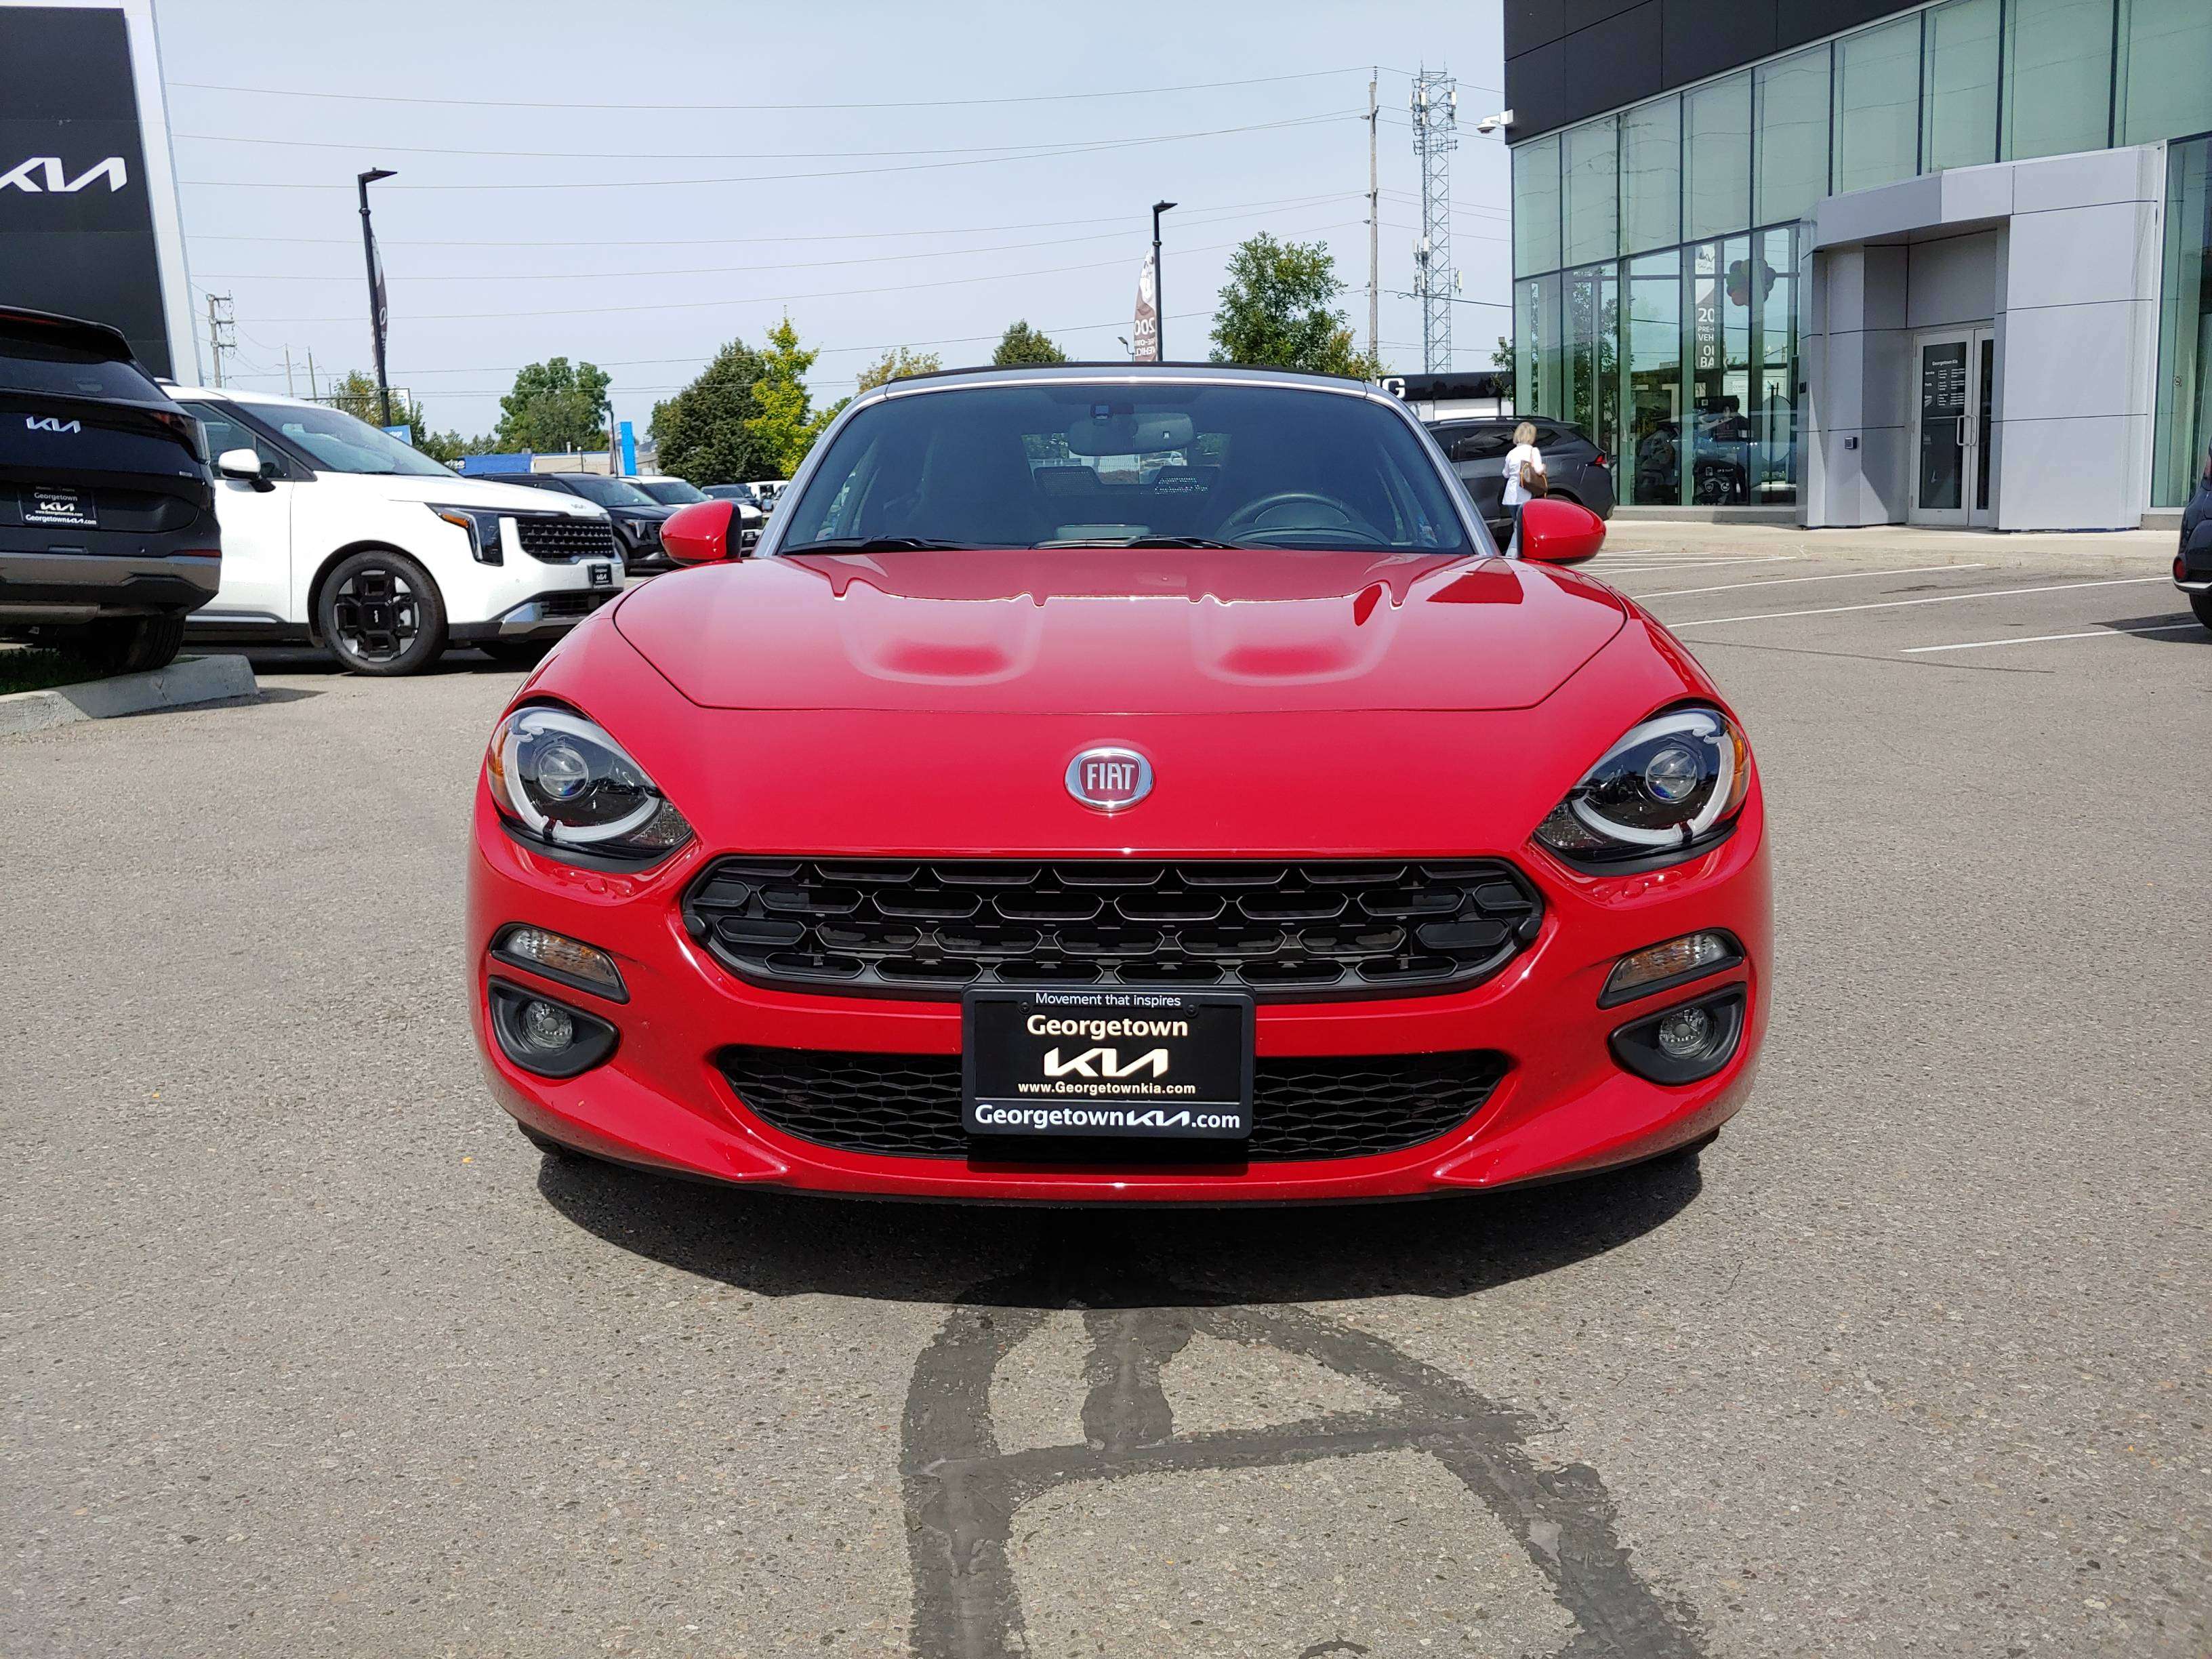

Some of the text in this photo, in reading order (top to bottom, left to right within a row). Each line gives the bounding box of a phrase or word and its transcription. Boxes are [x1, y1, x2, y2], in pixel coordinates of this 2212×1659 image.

[1376, 377, 1406, 398] G
[26, 416, 81, 434] KIA
[34, 492, 78, 501] Georgetown
[39, 501, 75, 512] KIA
[1086, 762, 1135, 790] FIAT
[1035, 992, 1181, 1008] Movement that inspires
[1027, 1014, 1188, 1040] Georgetown
[1044, 1047, 1168, 1078] KIA
[1018, 1081, 1196, 1096] www.Georgetownkia.com
